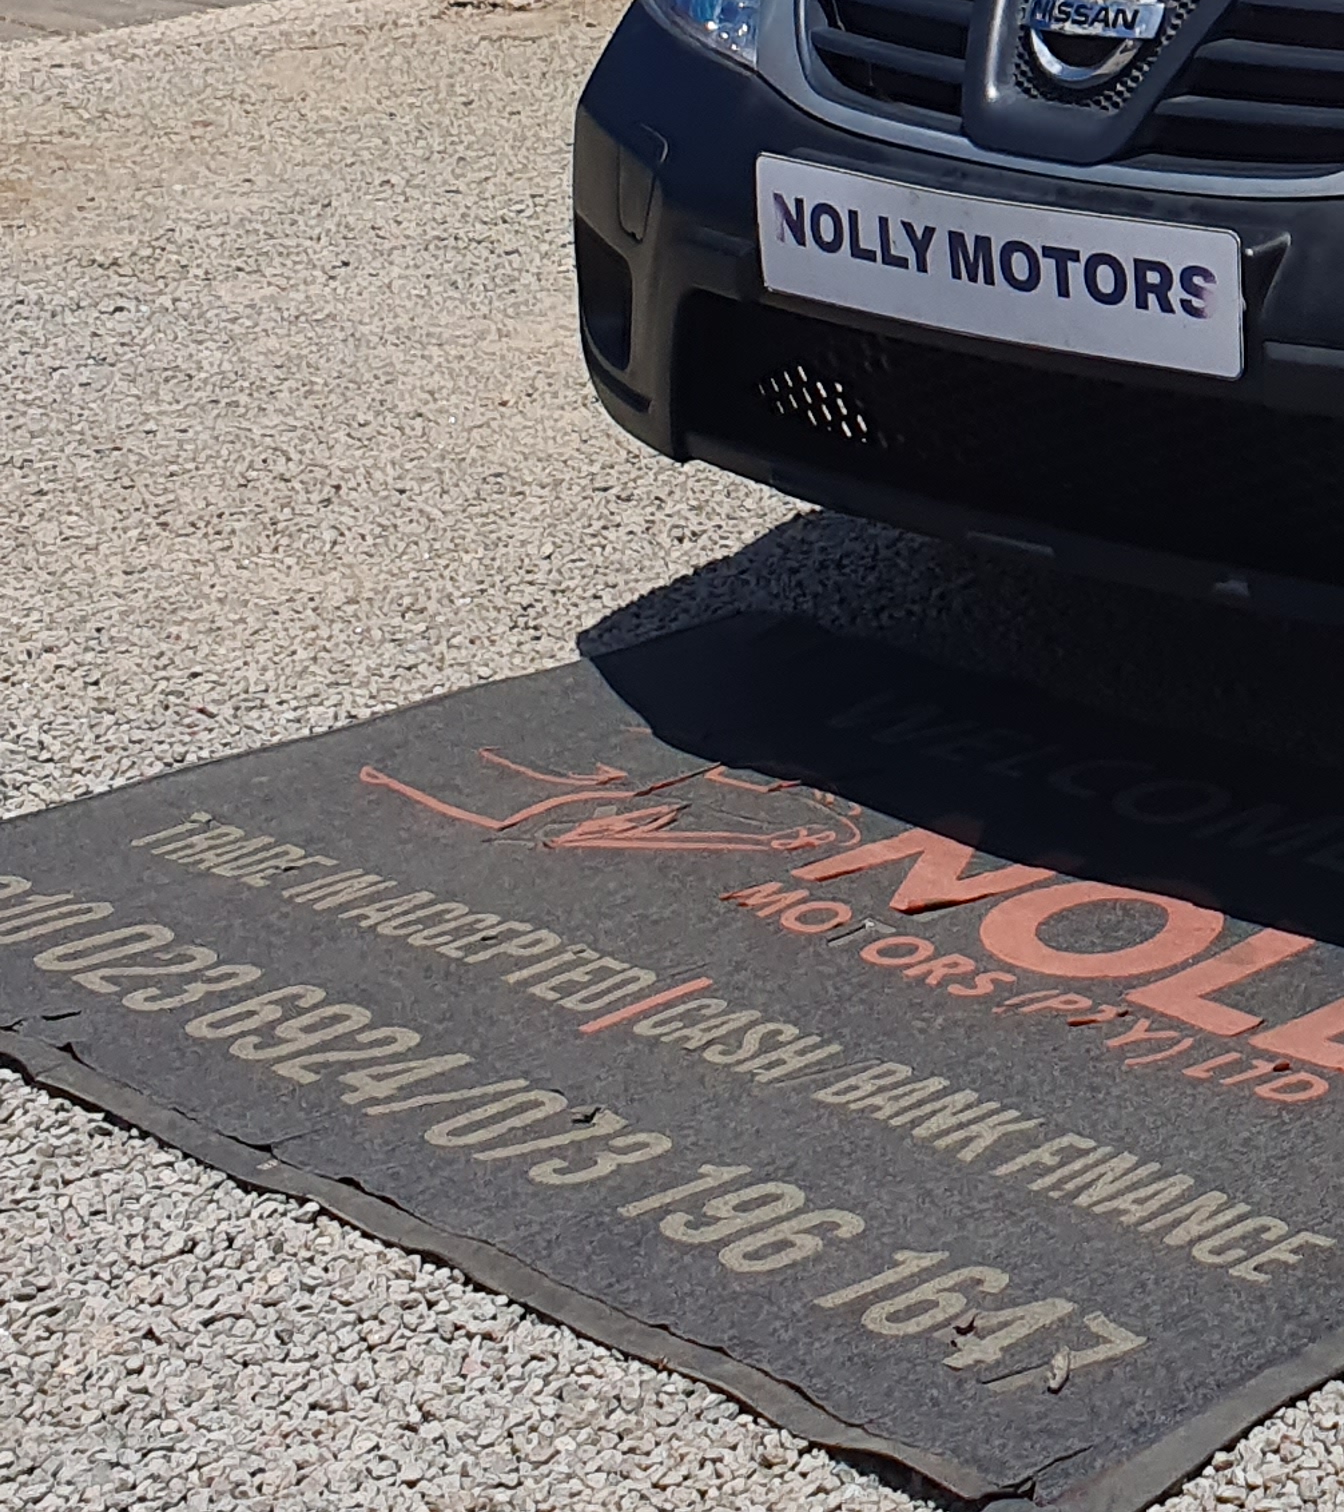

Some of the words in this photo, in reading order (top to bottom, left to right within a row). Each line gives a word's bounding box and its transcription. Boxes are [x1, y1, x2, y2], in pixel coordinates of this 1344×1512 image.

[773, 192, 936, 274] NOLLY
[948, 229, 1218, 320] MOTORS
[33, 924, 264, 1012] 023
[617, 1163, 866, 1274] 196
[812, 1250, 1148, 1392] 1647
[130, 810, 341, 887] TRADE
[281, 868, 399, 911] IN
[995, 1132, 1338, 1284] FINANCE
[1181, 1051, 1330, 1103] LTD
